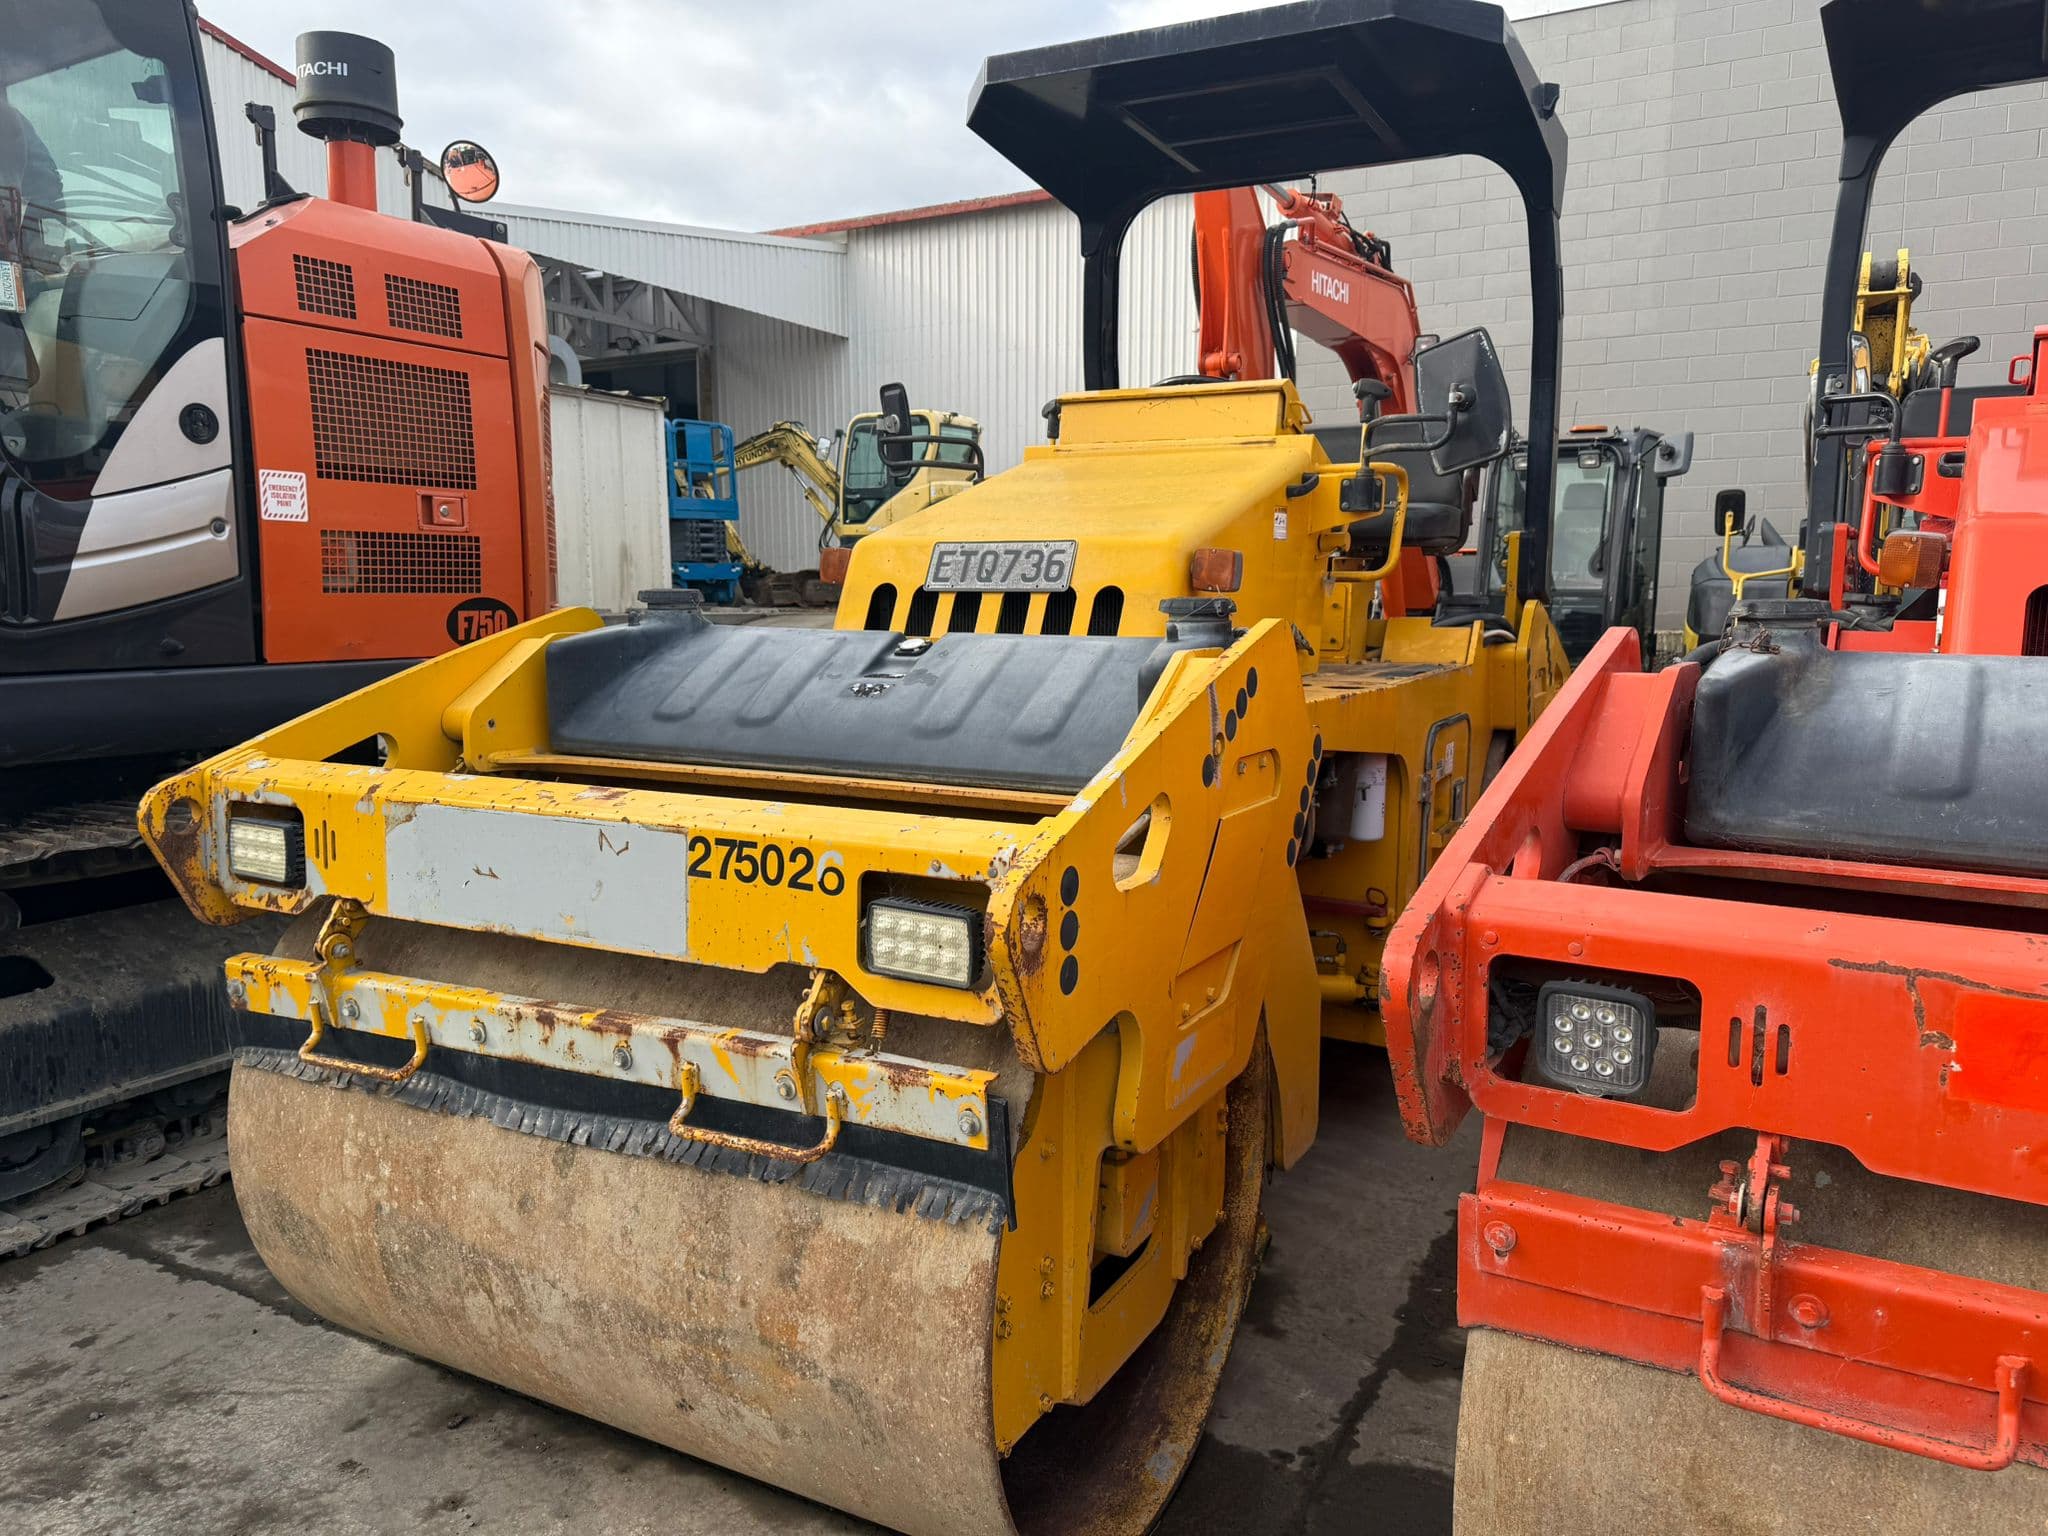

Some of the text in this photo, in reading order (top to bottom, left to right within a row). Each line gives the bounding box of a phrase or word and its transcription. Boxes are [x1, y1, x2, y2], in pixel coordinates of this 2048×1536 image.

[297, 61, 348, 78] ITACHI
[1311, 269, 1349, 305] HITACHI
[268, 484, 298, 492] EMERGENCY
[271, 492, 297, 500] ISOLATION
[932, 549, 1066, 583] ETQ736
[457, 609, 508, 641] F750
[688, 835, 845, 896] 275026
